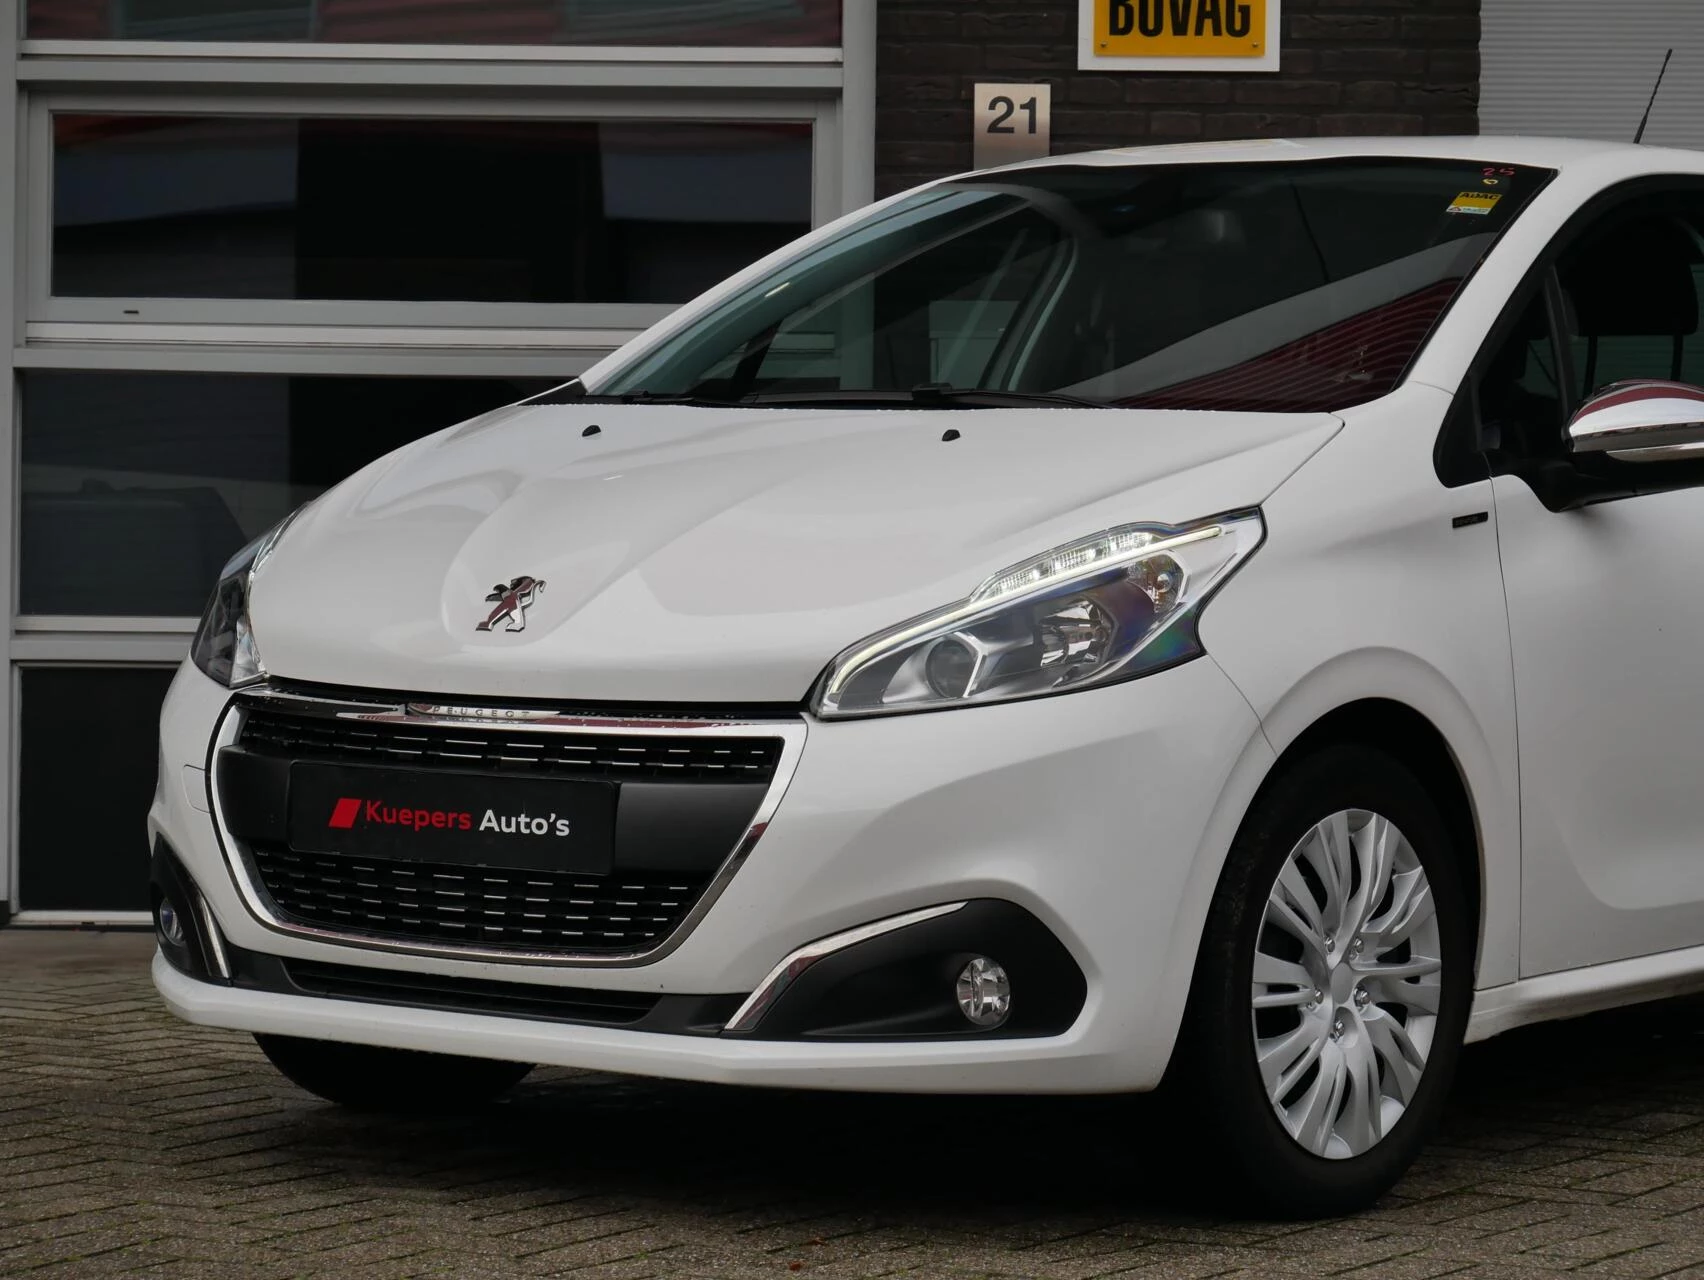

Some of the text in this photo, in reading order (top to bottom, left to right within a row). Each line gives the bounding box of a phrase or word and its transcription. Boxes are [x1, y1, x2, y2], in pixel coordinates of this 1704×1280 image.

[986, 96, 1037, 134] 21
[1460, 192, 1498, 200] ADAC
[431, 705, 530, 718] PEUGEOT
[366, 800, 570, 836] Kuepers Auto's
